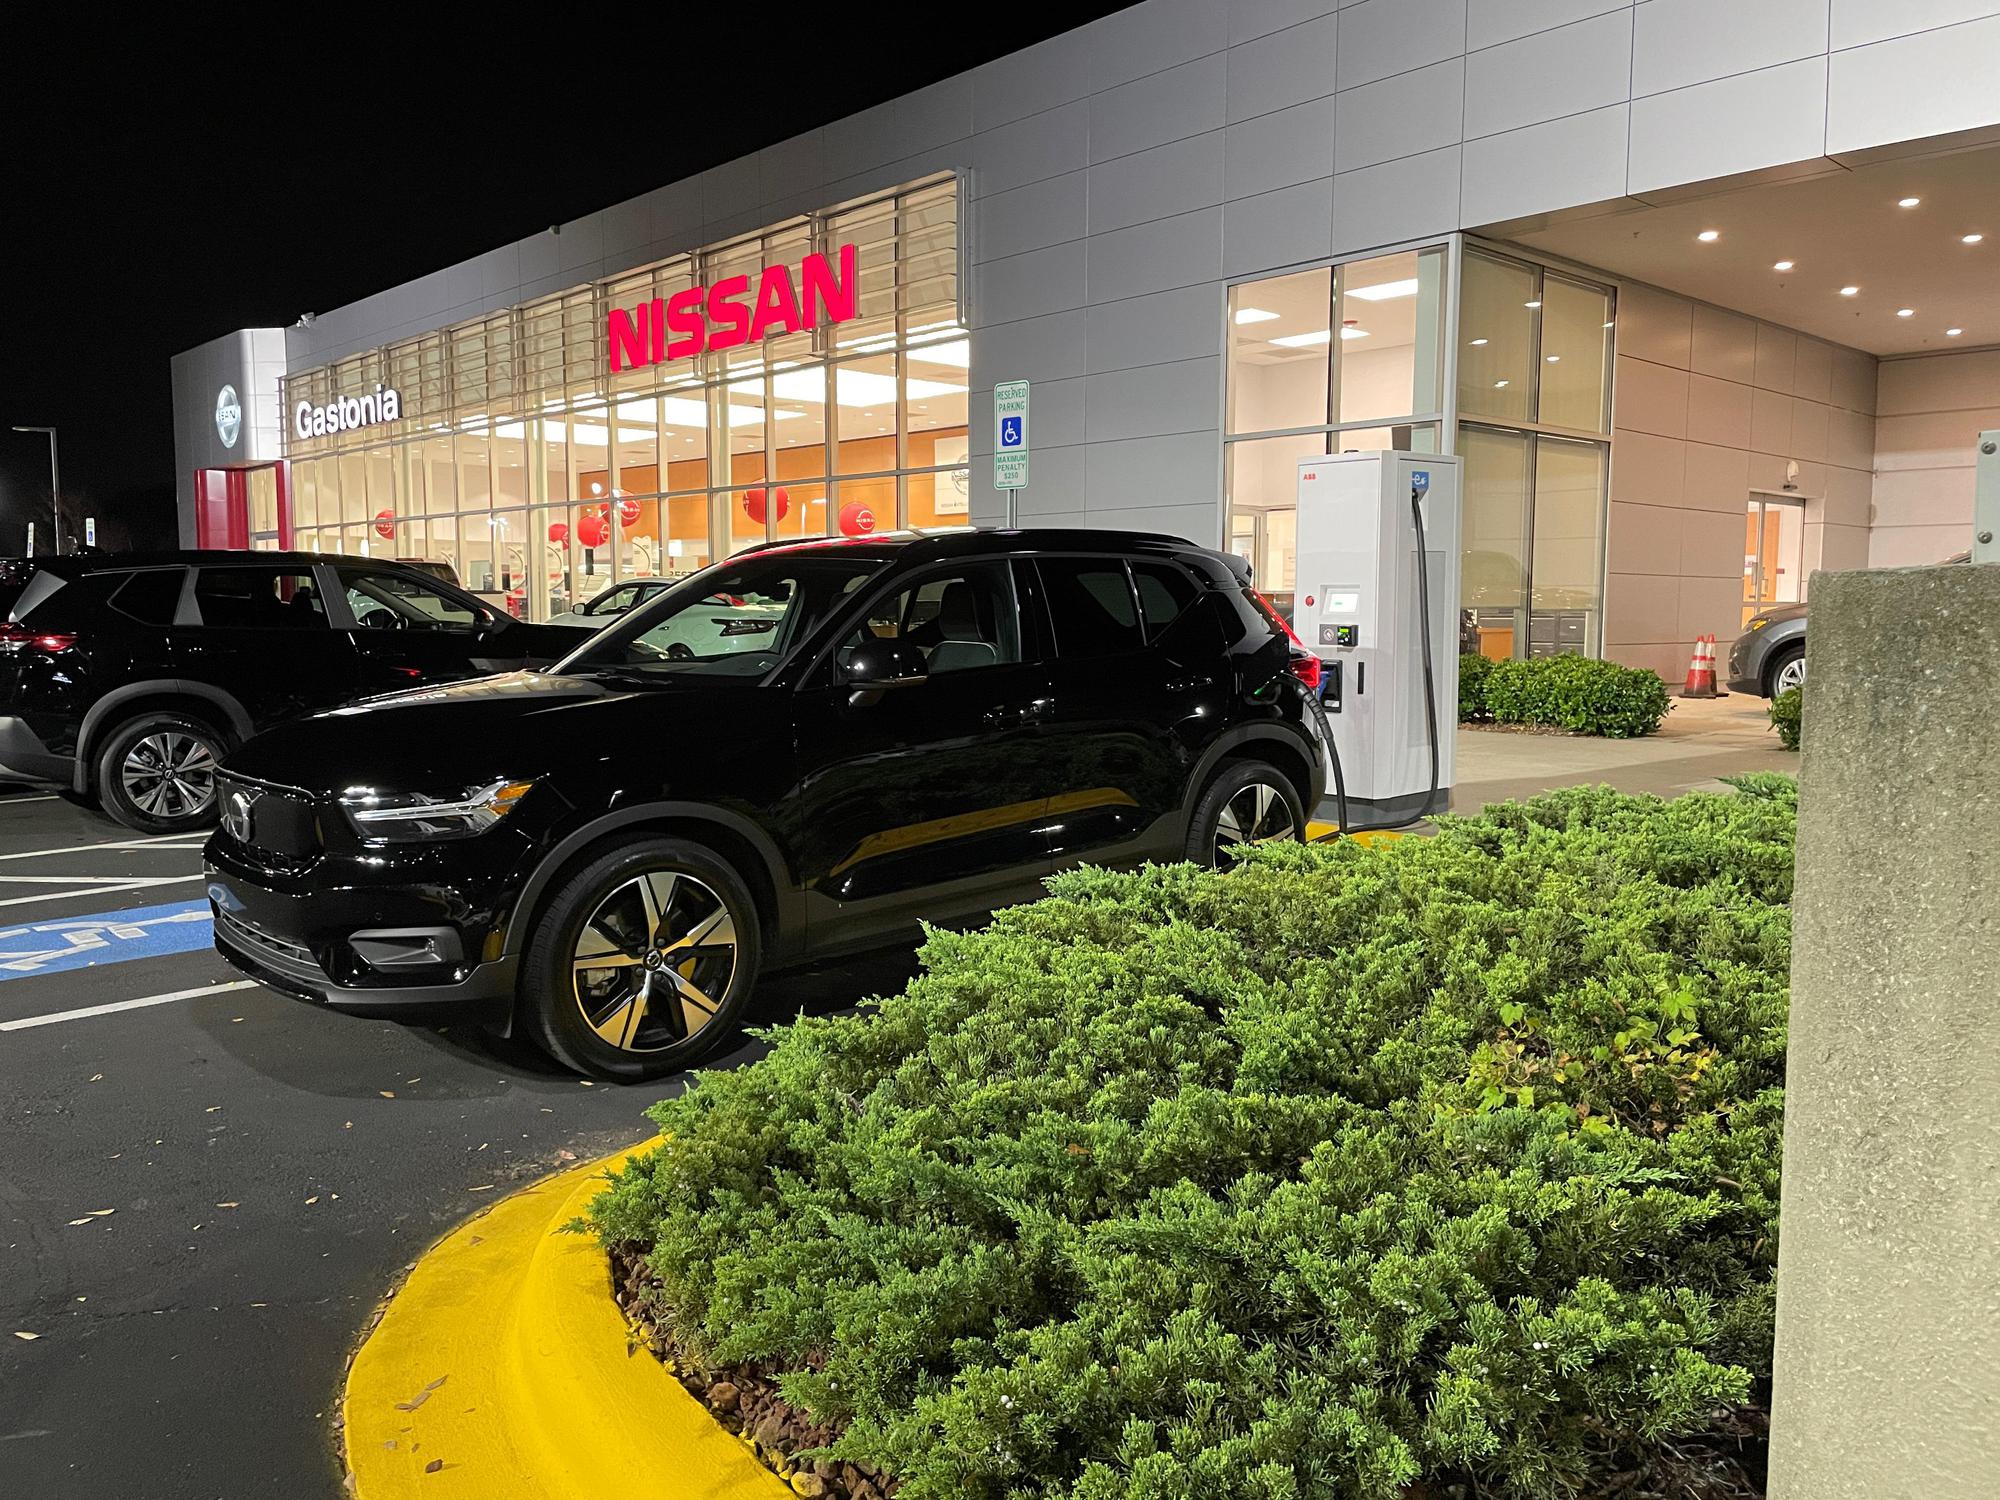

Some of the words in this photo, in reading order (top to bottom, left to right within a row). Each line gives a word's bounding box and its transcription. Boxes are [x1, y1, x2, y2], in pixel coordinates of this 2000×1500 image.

[608, 243, 856, 372] NISSAN
[997, 388, 1026, 400] RESERVED
[296, 383, 400, 439] Gastonia
[998, 401, 1025, 412] PARKING
[997, 454, 1026, 463] MAXIMUM
[997, 463, 1025, 472] PENALTY
[1004, 471, 1019, 480] $250
